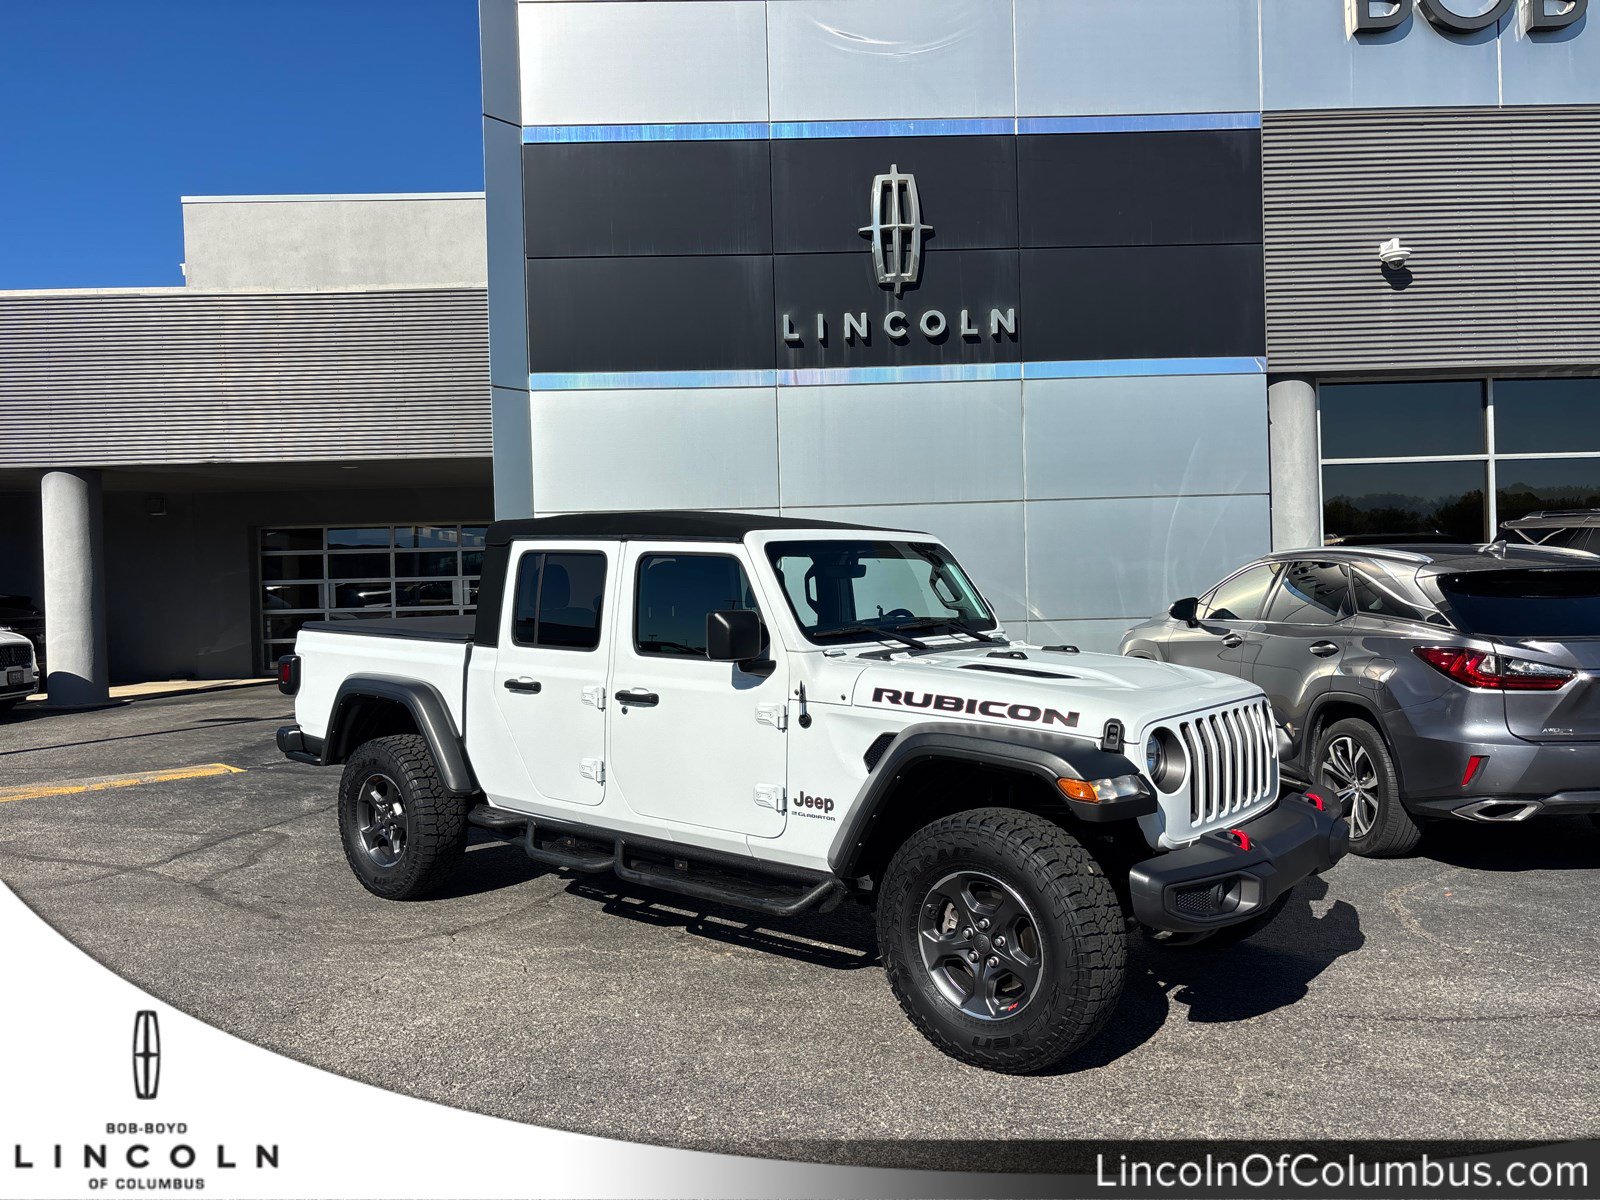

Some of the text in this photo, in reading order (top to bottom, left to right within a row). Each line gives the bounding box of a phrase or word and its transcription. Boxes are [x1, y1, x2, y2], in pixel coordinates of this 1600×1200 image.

[783, 308, 1016, 342] LINCOLN
[872, 687, 1080, 728] RUBICON
[793, 790, 834, 814] Jeep
[797, 811, 836, 822] GLADIATOR
